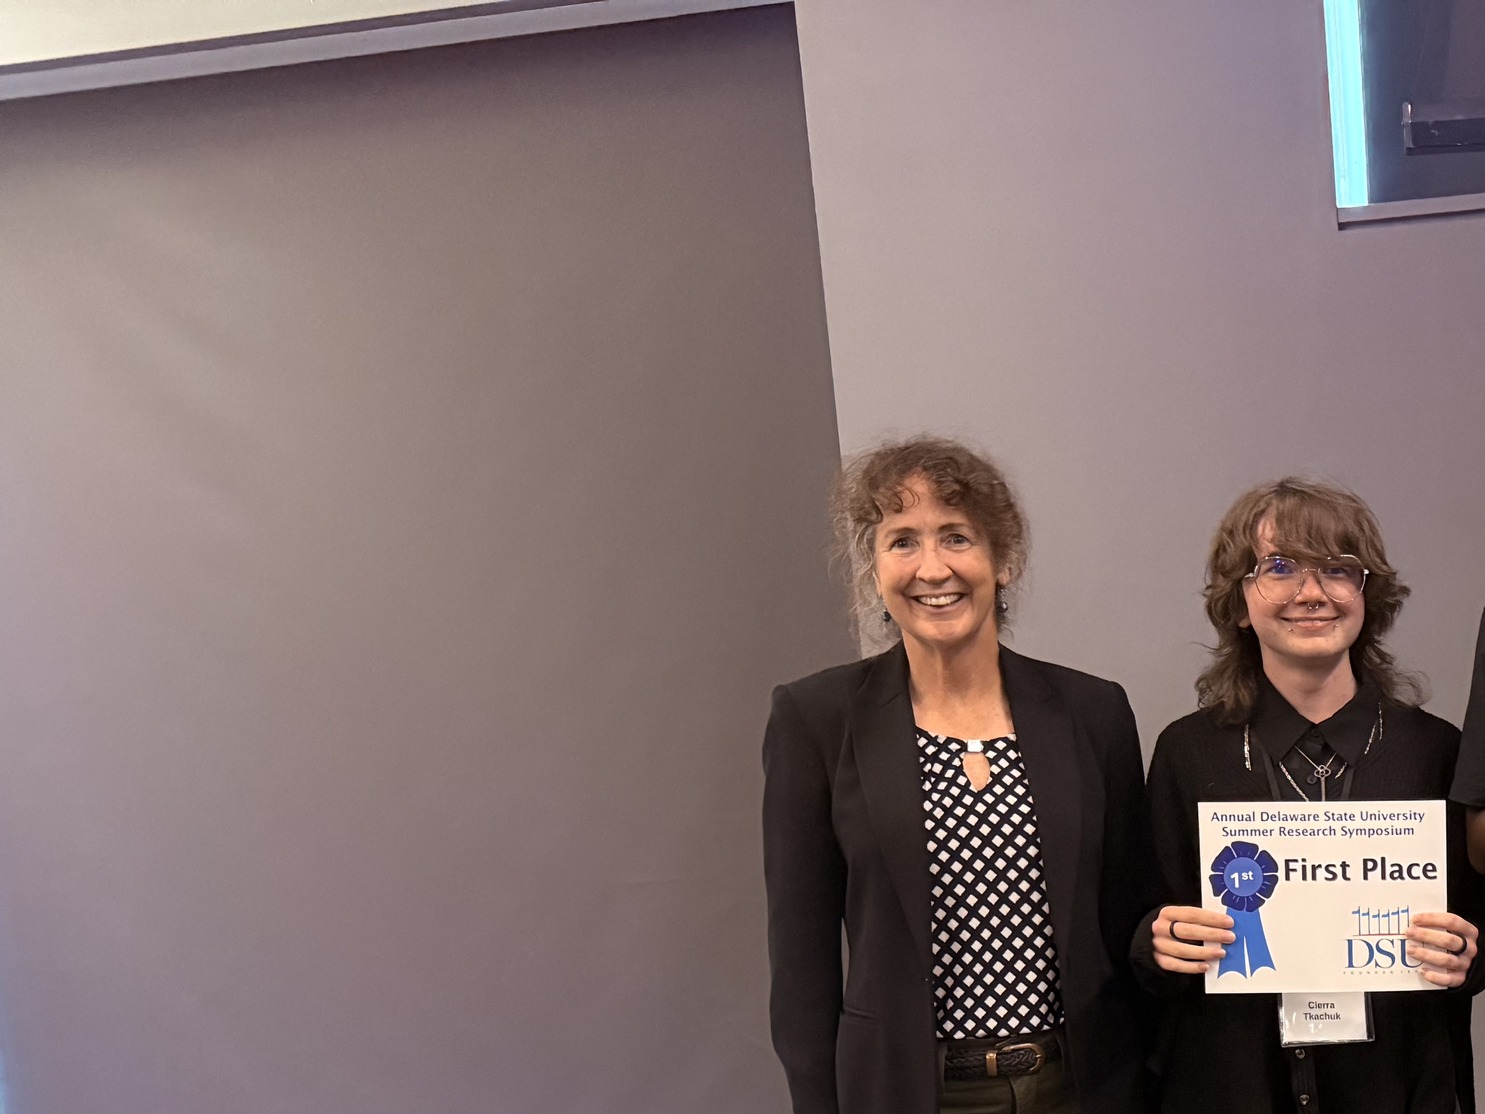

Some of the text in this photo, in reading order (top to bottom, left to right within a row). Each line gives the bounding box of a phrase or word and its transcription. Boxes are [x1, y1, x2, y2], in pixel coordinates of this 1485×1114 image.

[1211, 810, 1425, 823] Annual Delaware State University
[1222, 825, 1414, 838] Summer Research Symposium
[1284, 857, 1437, 881] First Place
[1231, 871, 1254, 888] 1st
[1308, 1001, 1336, 1010] Cierra
[1302, 1012, 1342, 1021] Tkachuk
